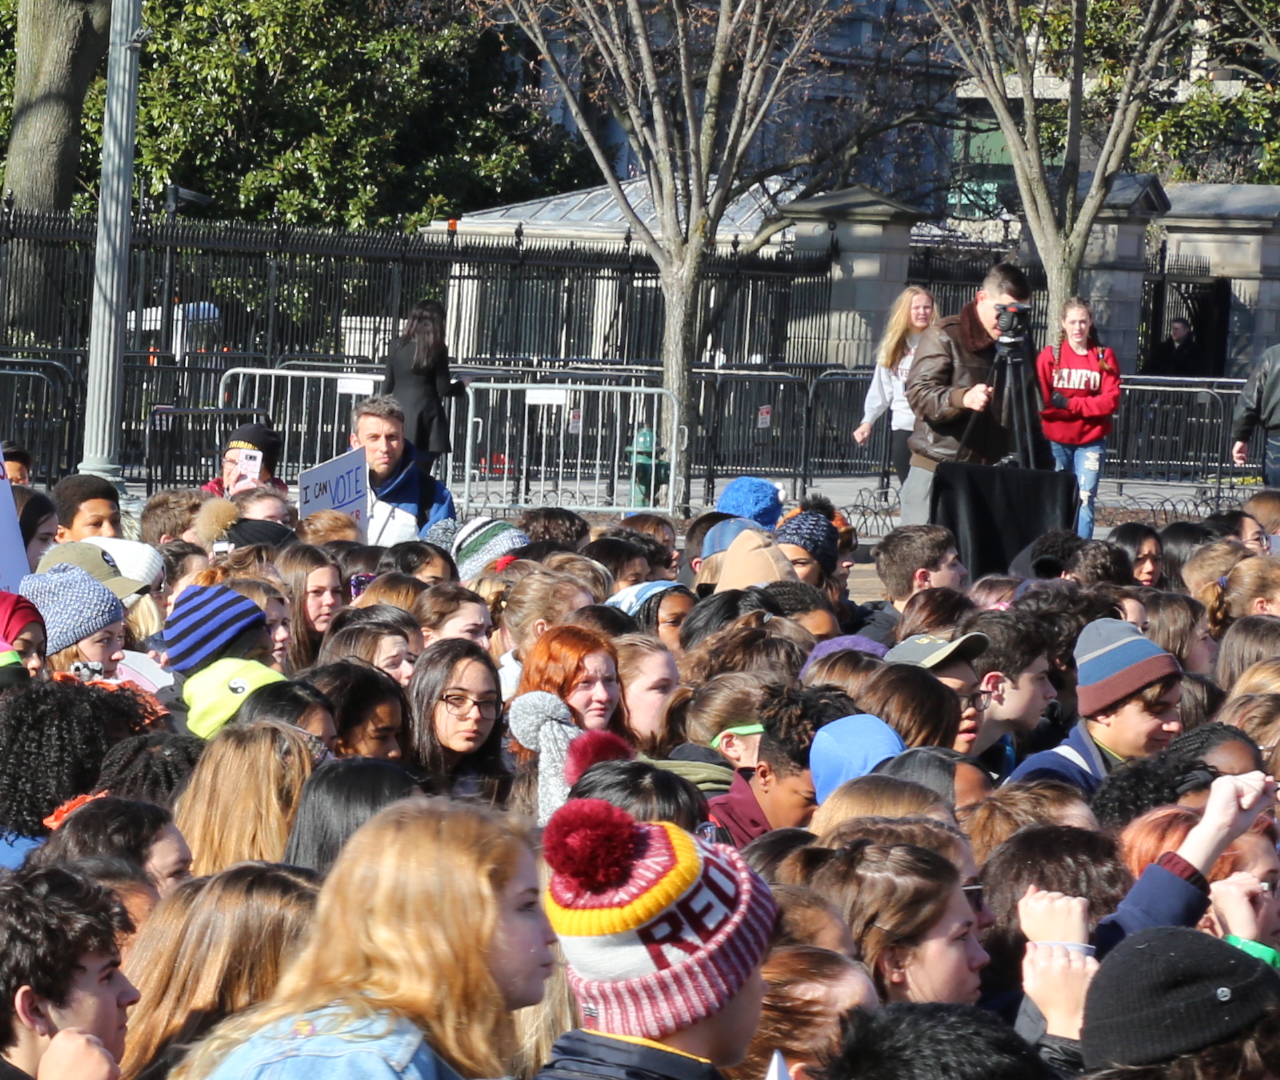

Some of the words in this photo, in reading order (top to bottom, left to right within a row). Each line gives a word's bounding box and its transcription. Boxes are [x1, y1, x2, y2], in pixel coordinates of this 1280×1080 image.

[303, 484, 312, 506] I
[313, 481, 328, 499] CAN
[327, 466, 362, 505] VOTE
